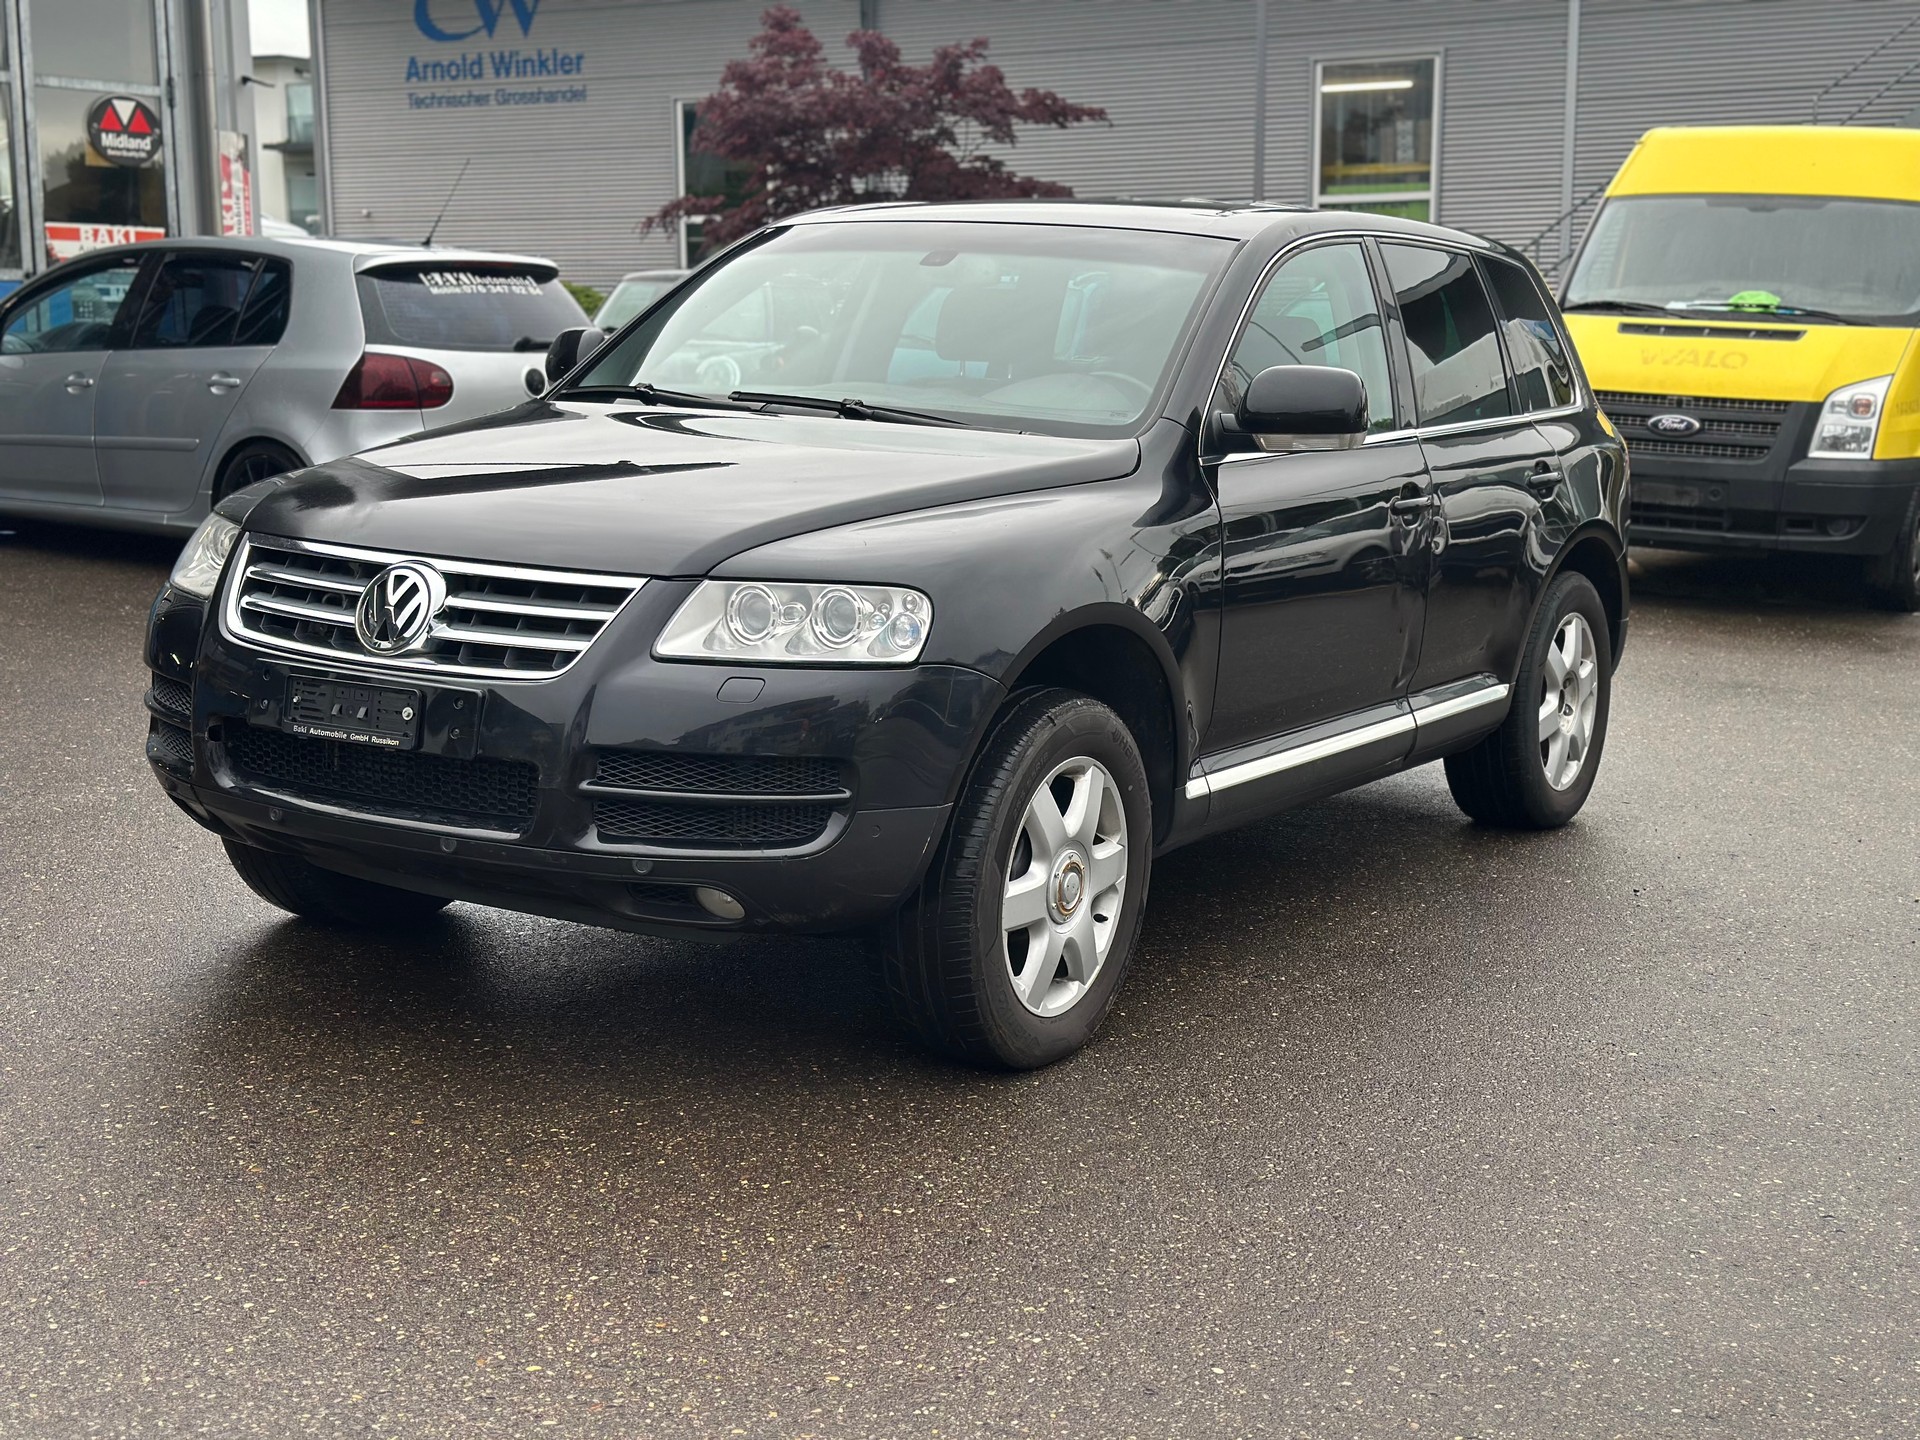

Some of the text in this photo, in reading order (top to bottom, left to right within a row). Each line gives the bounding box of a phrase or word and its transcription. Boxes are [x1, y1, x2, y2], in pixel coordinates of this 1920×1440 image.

[406, 48, 585, 82] Arnold Winkler
[407, 84, 587, 109] Technischer Grosshandel
[101, 132, 152, 151] Midland
[80, 225, 137, 245] BAKI
[293, 725, 400, 747] Baki Automobile GmbH Russikon
